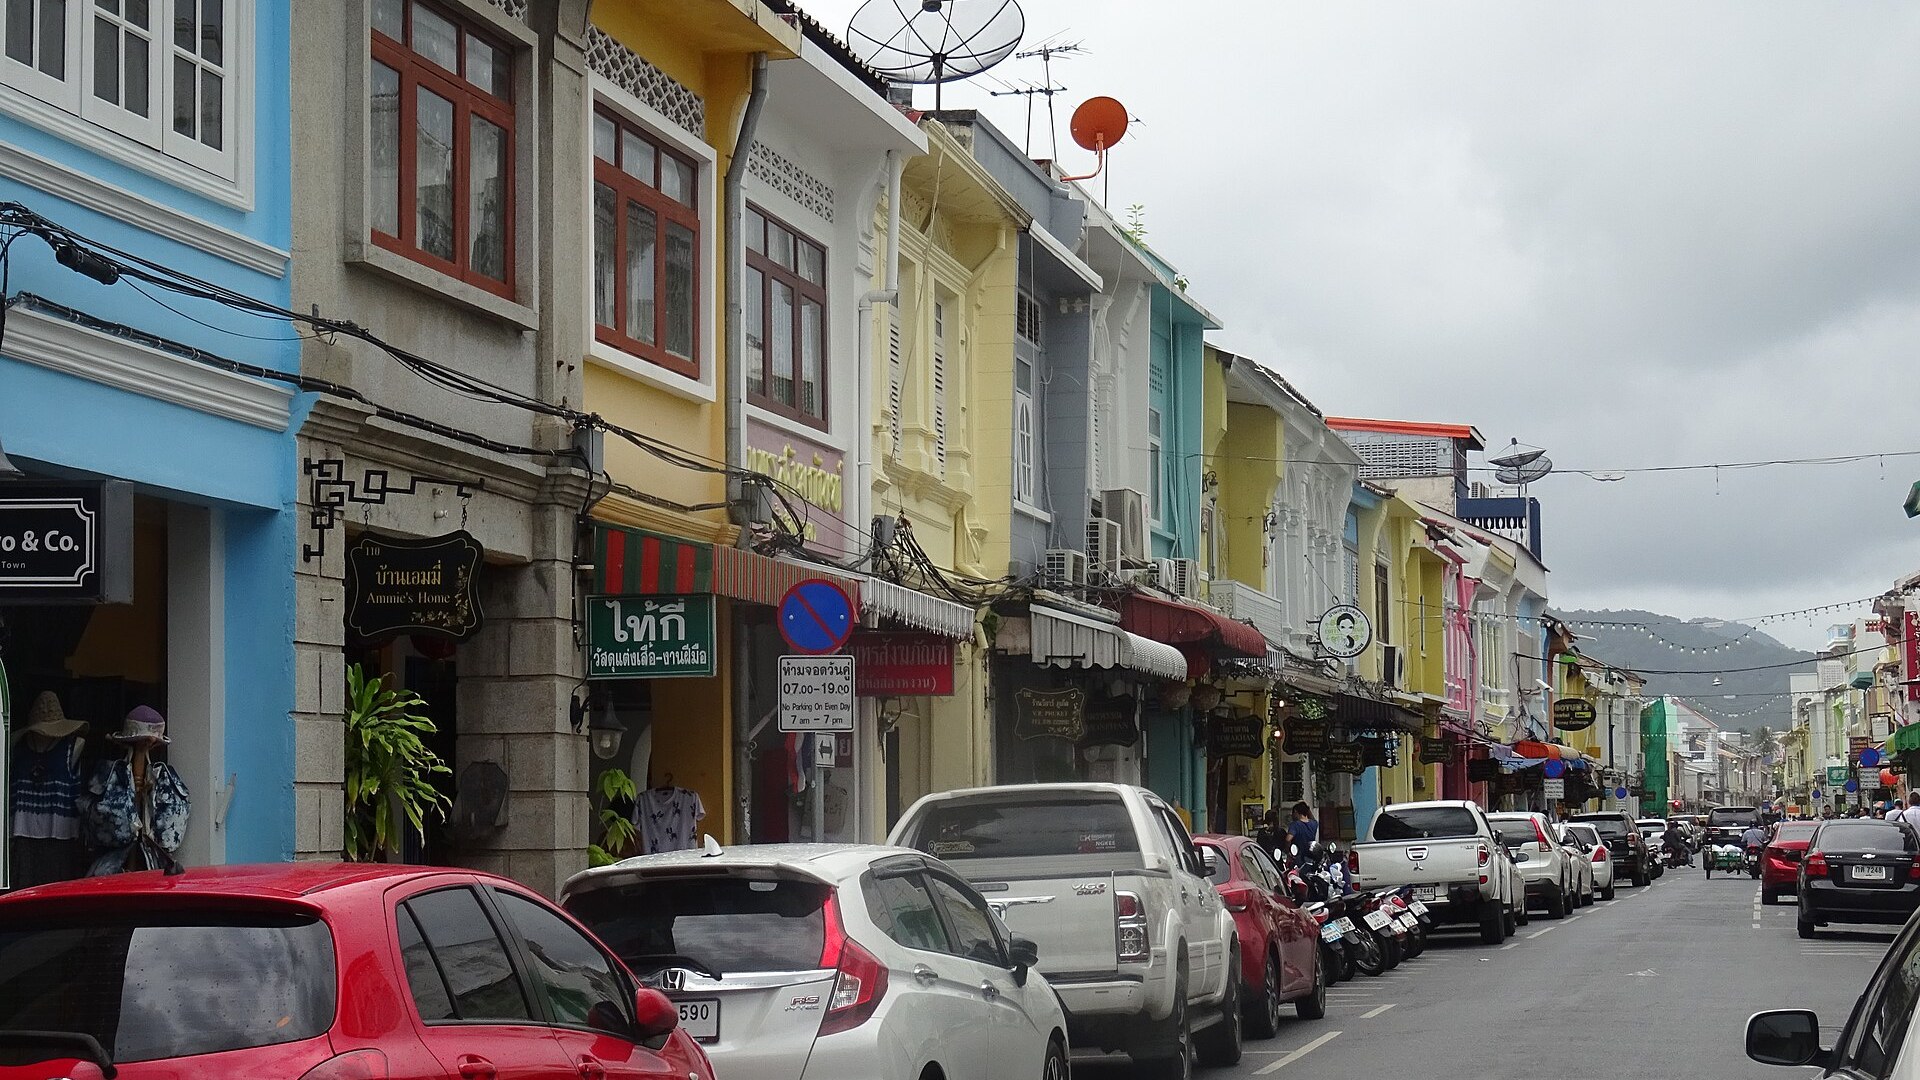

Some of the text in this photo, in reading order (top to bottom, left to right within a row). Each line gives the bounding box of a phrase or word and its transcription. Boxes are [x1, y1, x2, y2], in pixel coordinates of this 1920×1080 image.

[0, 530, 79, 552] o & Co.
[365, 546, 380, 556] 110
[1, 560, 26, 569] Town
[366, 592, 450, 604] Ammie's Home
[782, 661, 850, 681] ห้ามจอดวันคู่
[782, 702, 851, 712] No Parking On Even Day
[790, 714, 797, 724] 7
[823, 714, 830, 724] 7
[831, 717, 843, 726] pm
[1071, 882, 1107, 891] VIGO
[790, 995, 820, 1005] RS
